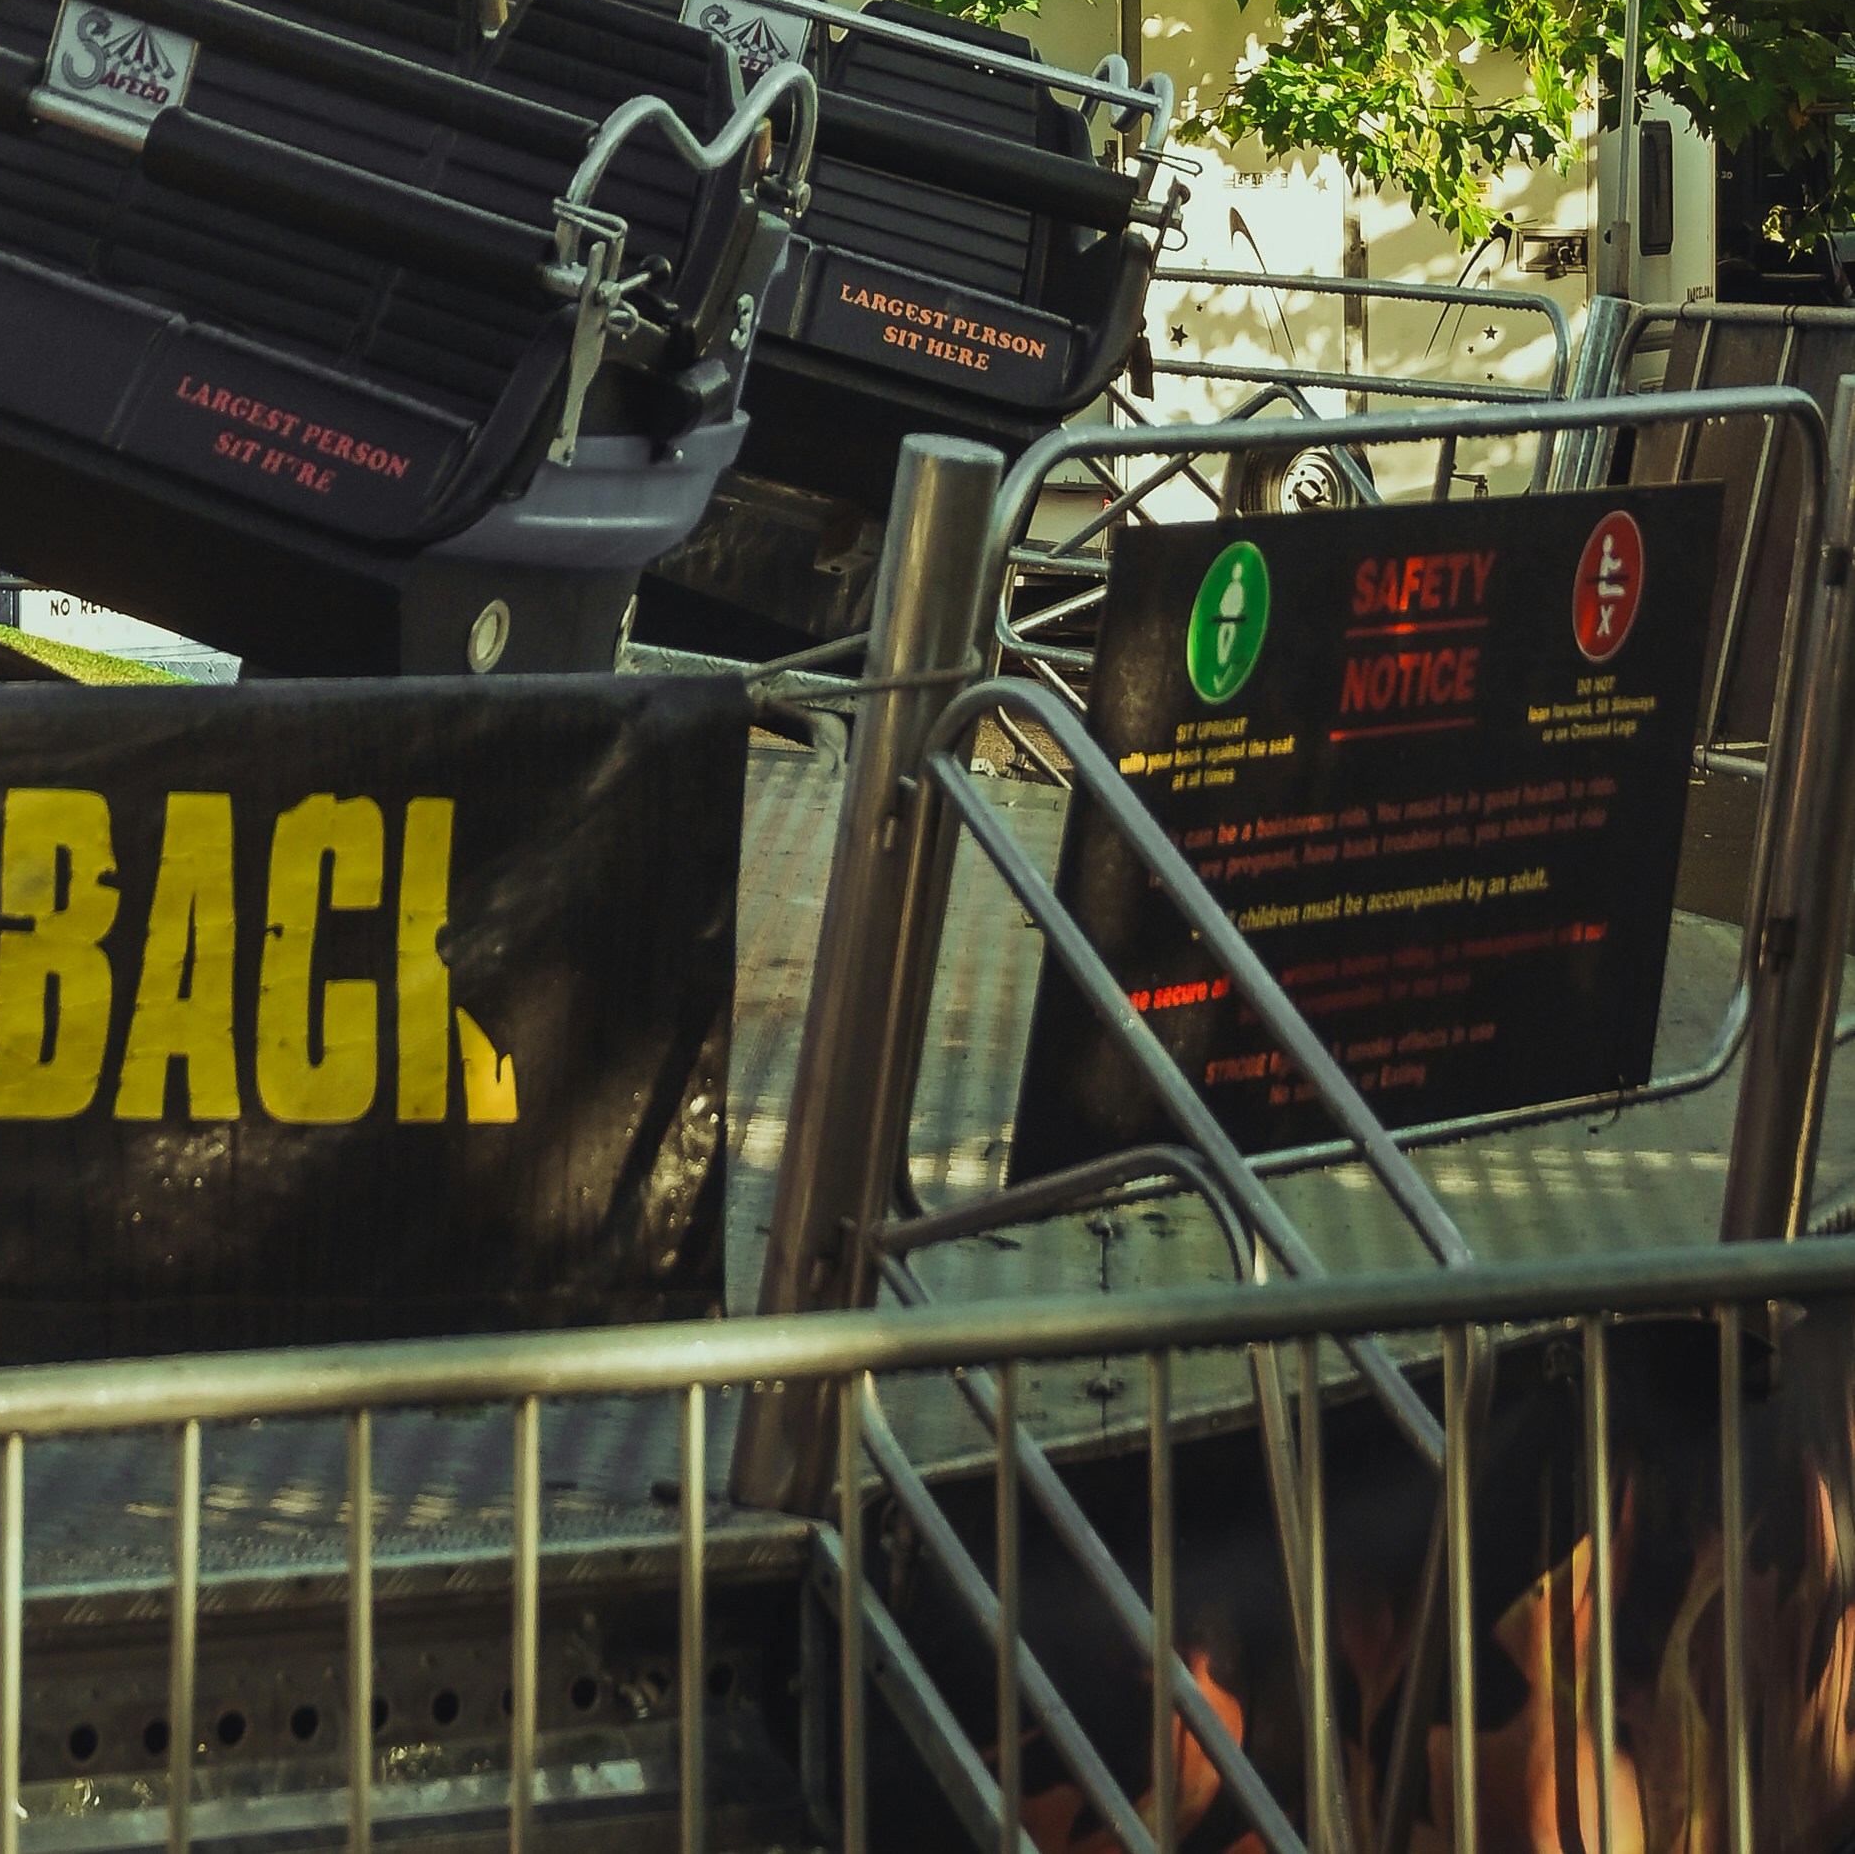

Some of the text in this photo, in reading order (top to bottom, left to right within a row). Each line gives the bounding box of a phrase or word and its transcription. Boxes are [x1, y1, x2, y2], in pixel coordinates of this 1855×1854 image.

[840, 283, 949, 330] LARGEST
[883, 324, 991, 371] SIT HERE
[177, 375, 411, 479] LARGEST PERSON
[214, 430, 261, 464] SIT
[50, 599, 71, 616] NO
[1352, 551, 1495, 617] SAFETY
[1339, 647, 1480, 714] NOTICE
[1238, 902, 1299, 932] children
[1301, 893, 1340, 923] must
[1343, 891, 1364, 918] be
[1367, 876, 1465, 914] accompanied
[1466, 875, 1485, 905] by
[1487, 875, 1507, 896] an
[1509, 866, 1549, 892] adult.
[1153, 980, 1208, 1009] secure
